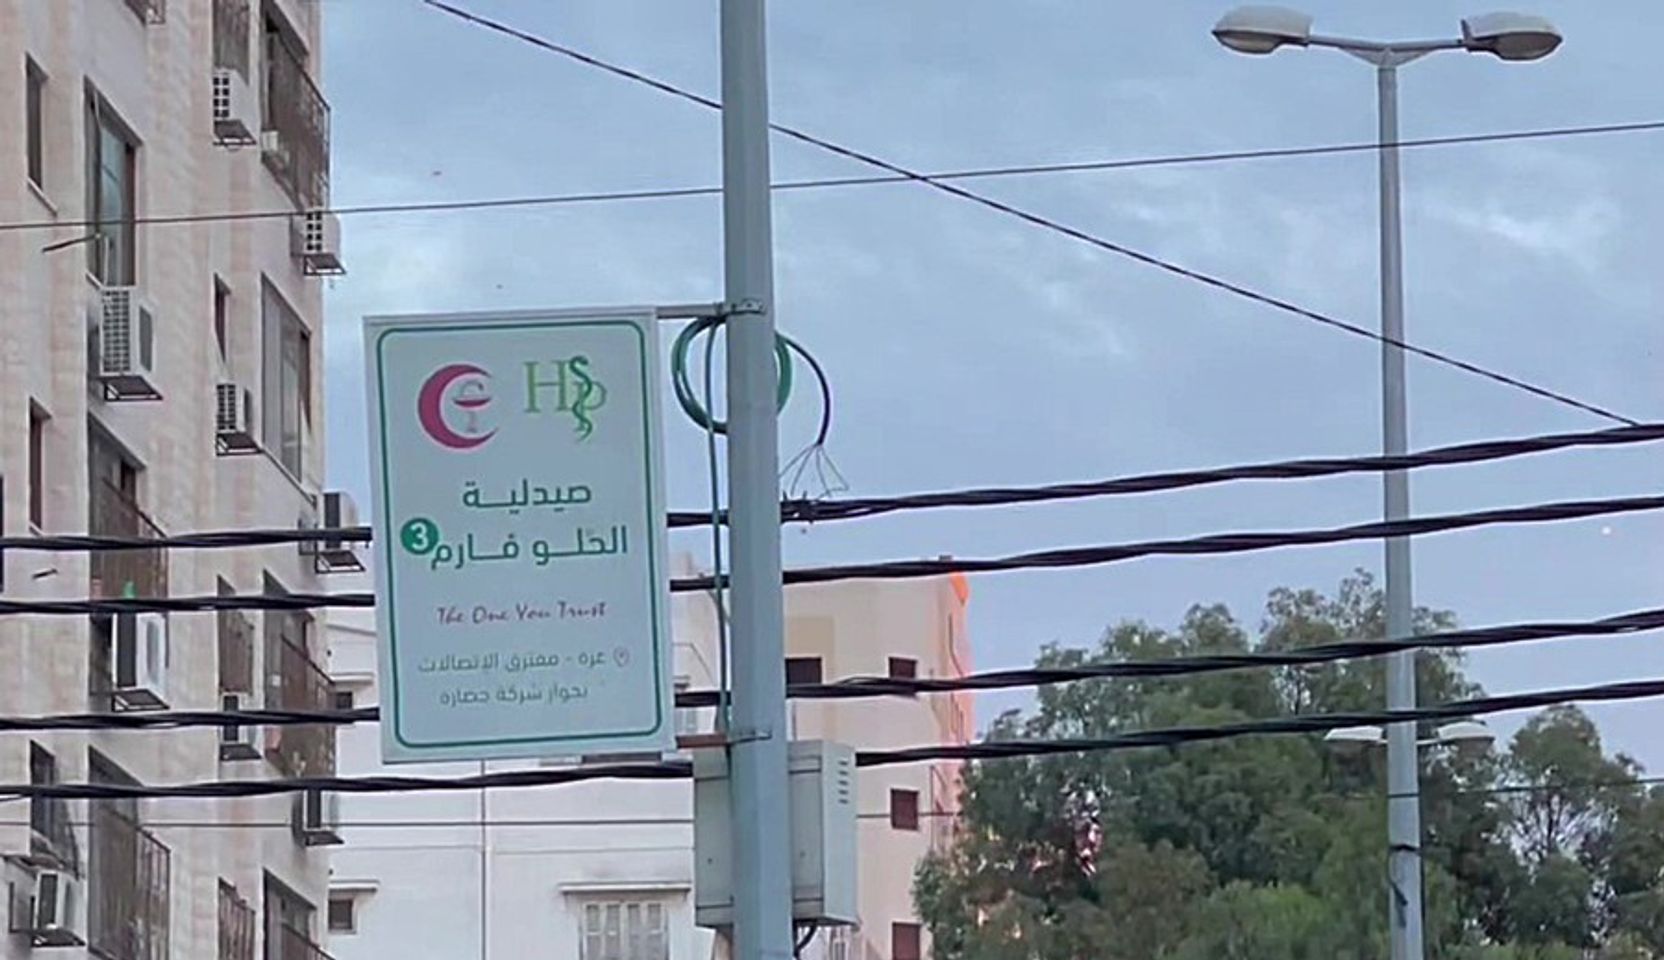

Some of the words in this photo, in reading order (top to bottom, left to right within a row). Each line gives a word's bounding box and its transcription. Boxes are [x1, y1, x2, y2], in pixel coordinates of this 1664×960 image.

[462, 479, 592, 515] صيدلية
[410, 522, 430, 550] 3
[431, 532, 519, 571] فارم
[533, 525, 628, 567] الحلو
[437, 605, 464, 624] The
[472, 605, 508, 625] One
[515, 602, 551, 621] You
[557, 600, 606, 619] Trust
